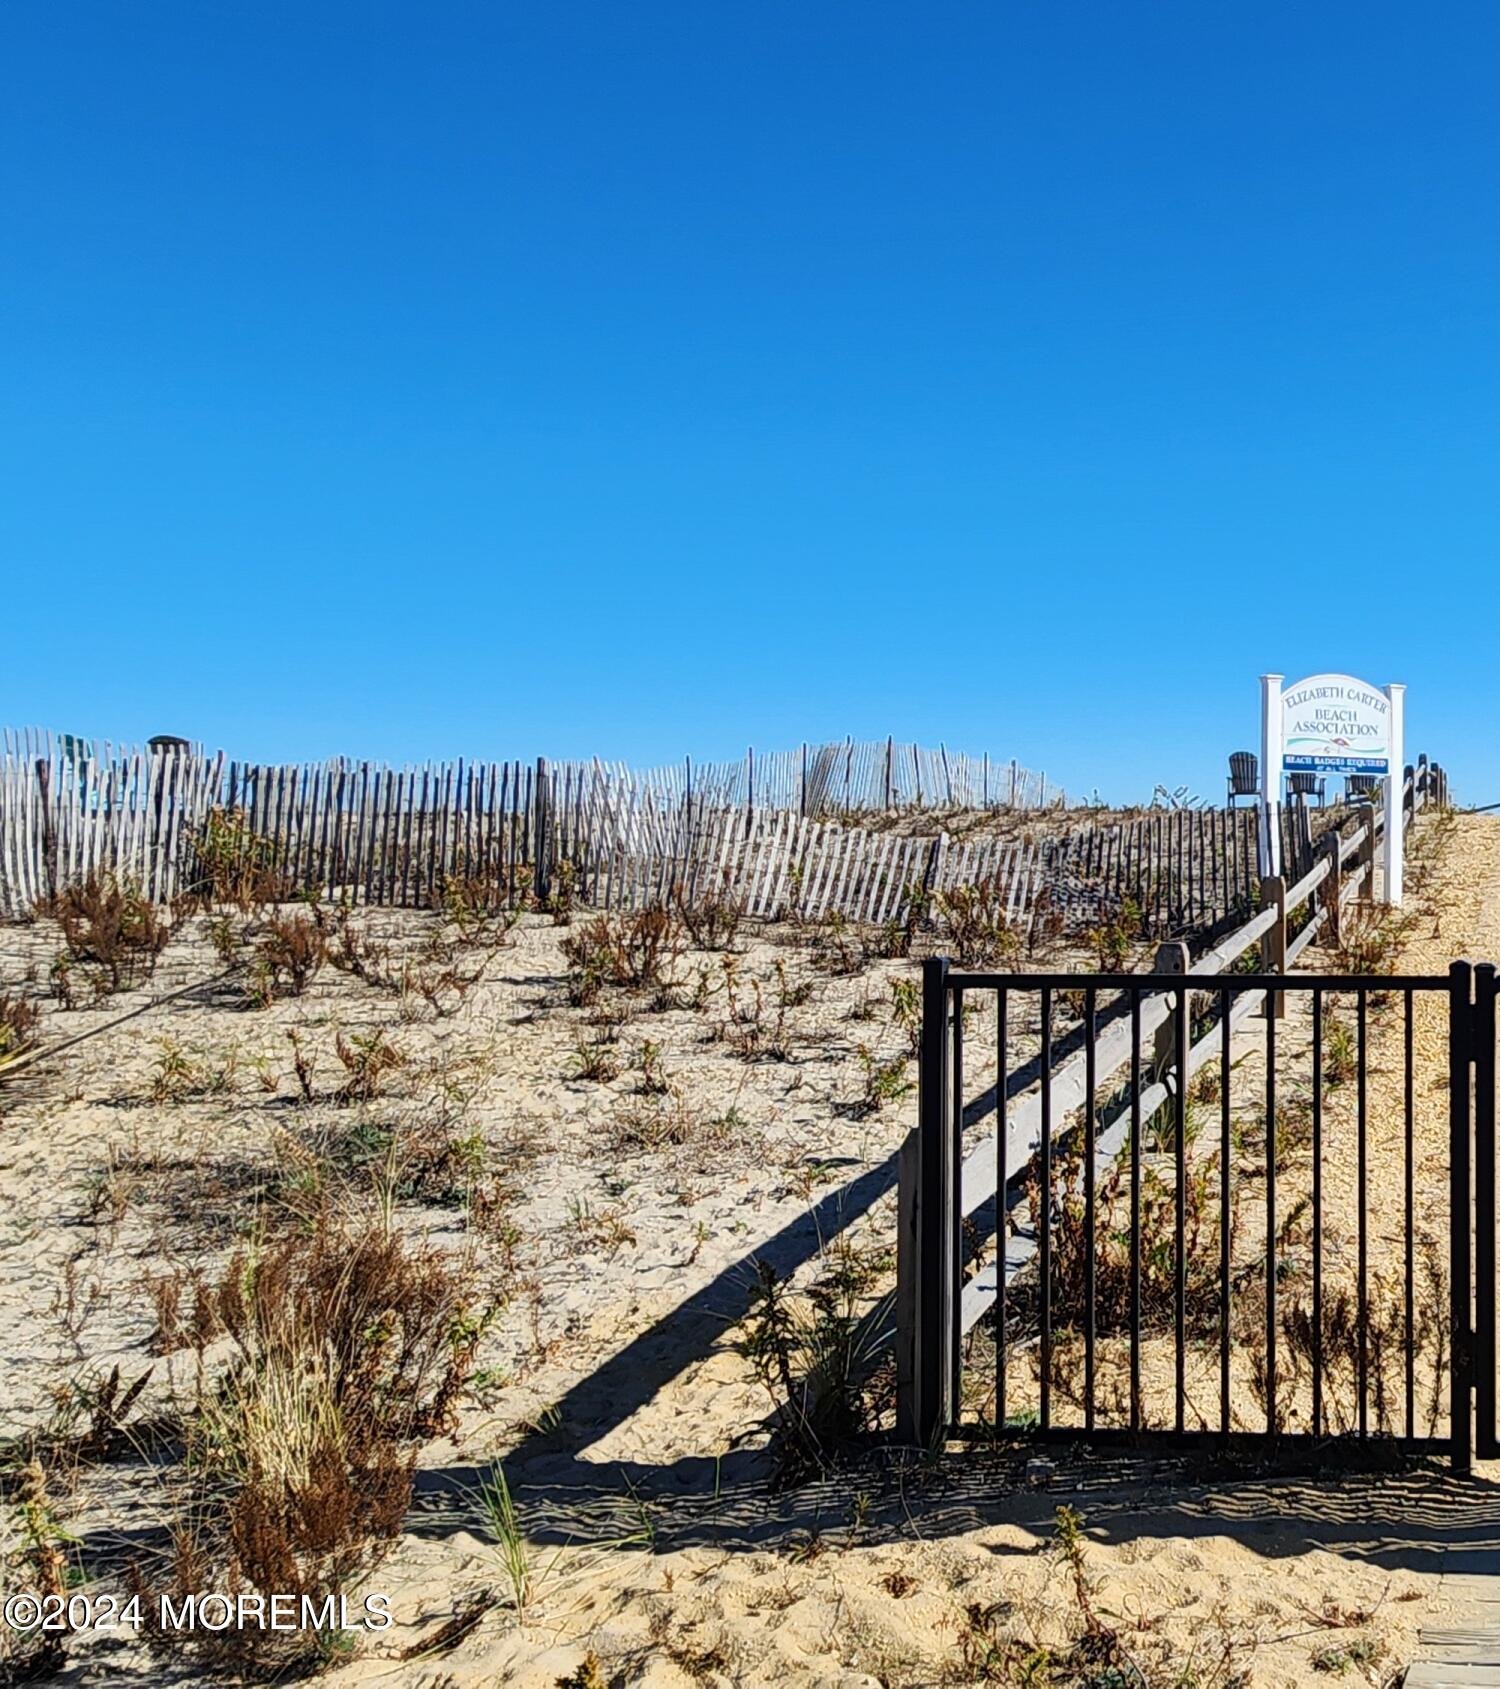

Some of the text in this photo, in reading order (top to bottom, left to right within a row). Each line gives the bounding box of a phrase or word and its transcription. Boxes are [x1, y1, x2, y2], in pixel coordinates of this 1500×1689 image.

[1285, 687, 1388, 714] ELIZABETH CARTER
[1315, 709, 1358, 722] BEACH
[1293, 721, 1379, 735] ASSOCIATION
[1285, 756, 1386, 768] BEACH BADGES REQUIRED
